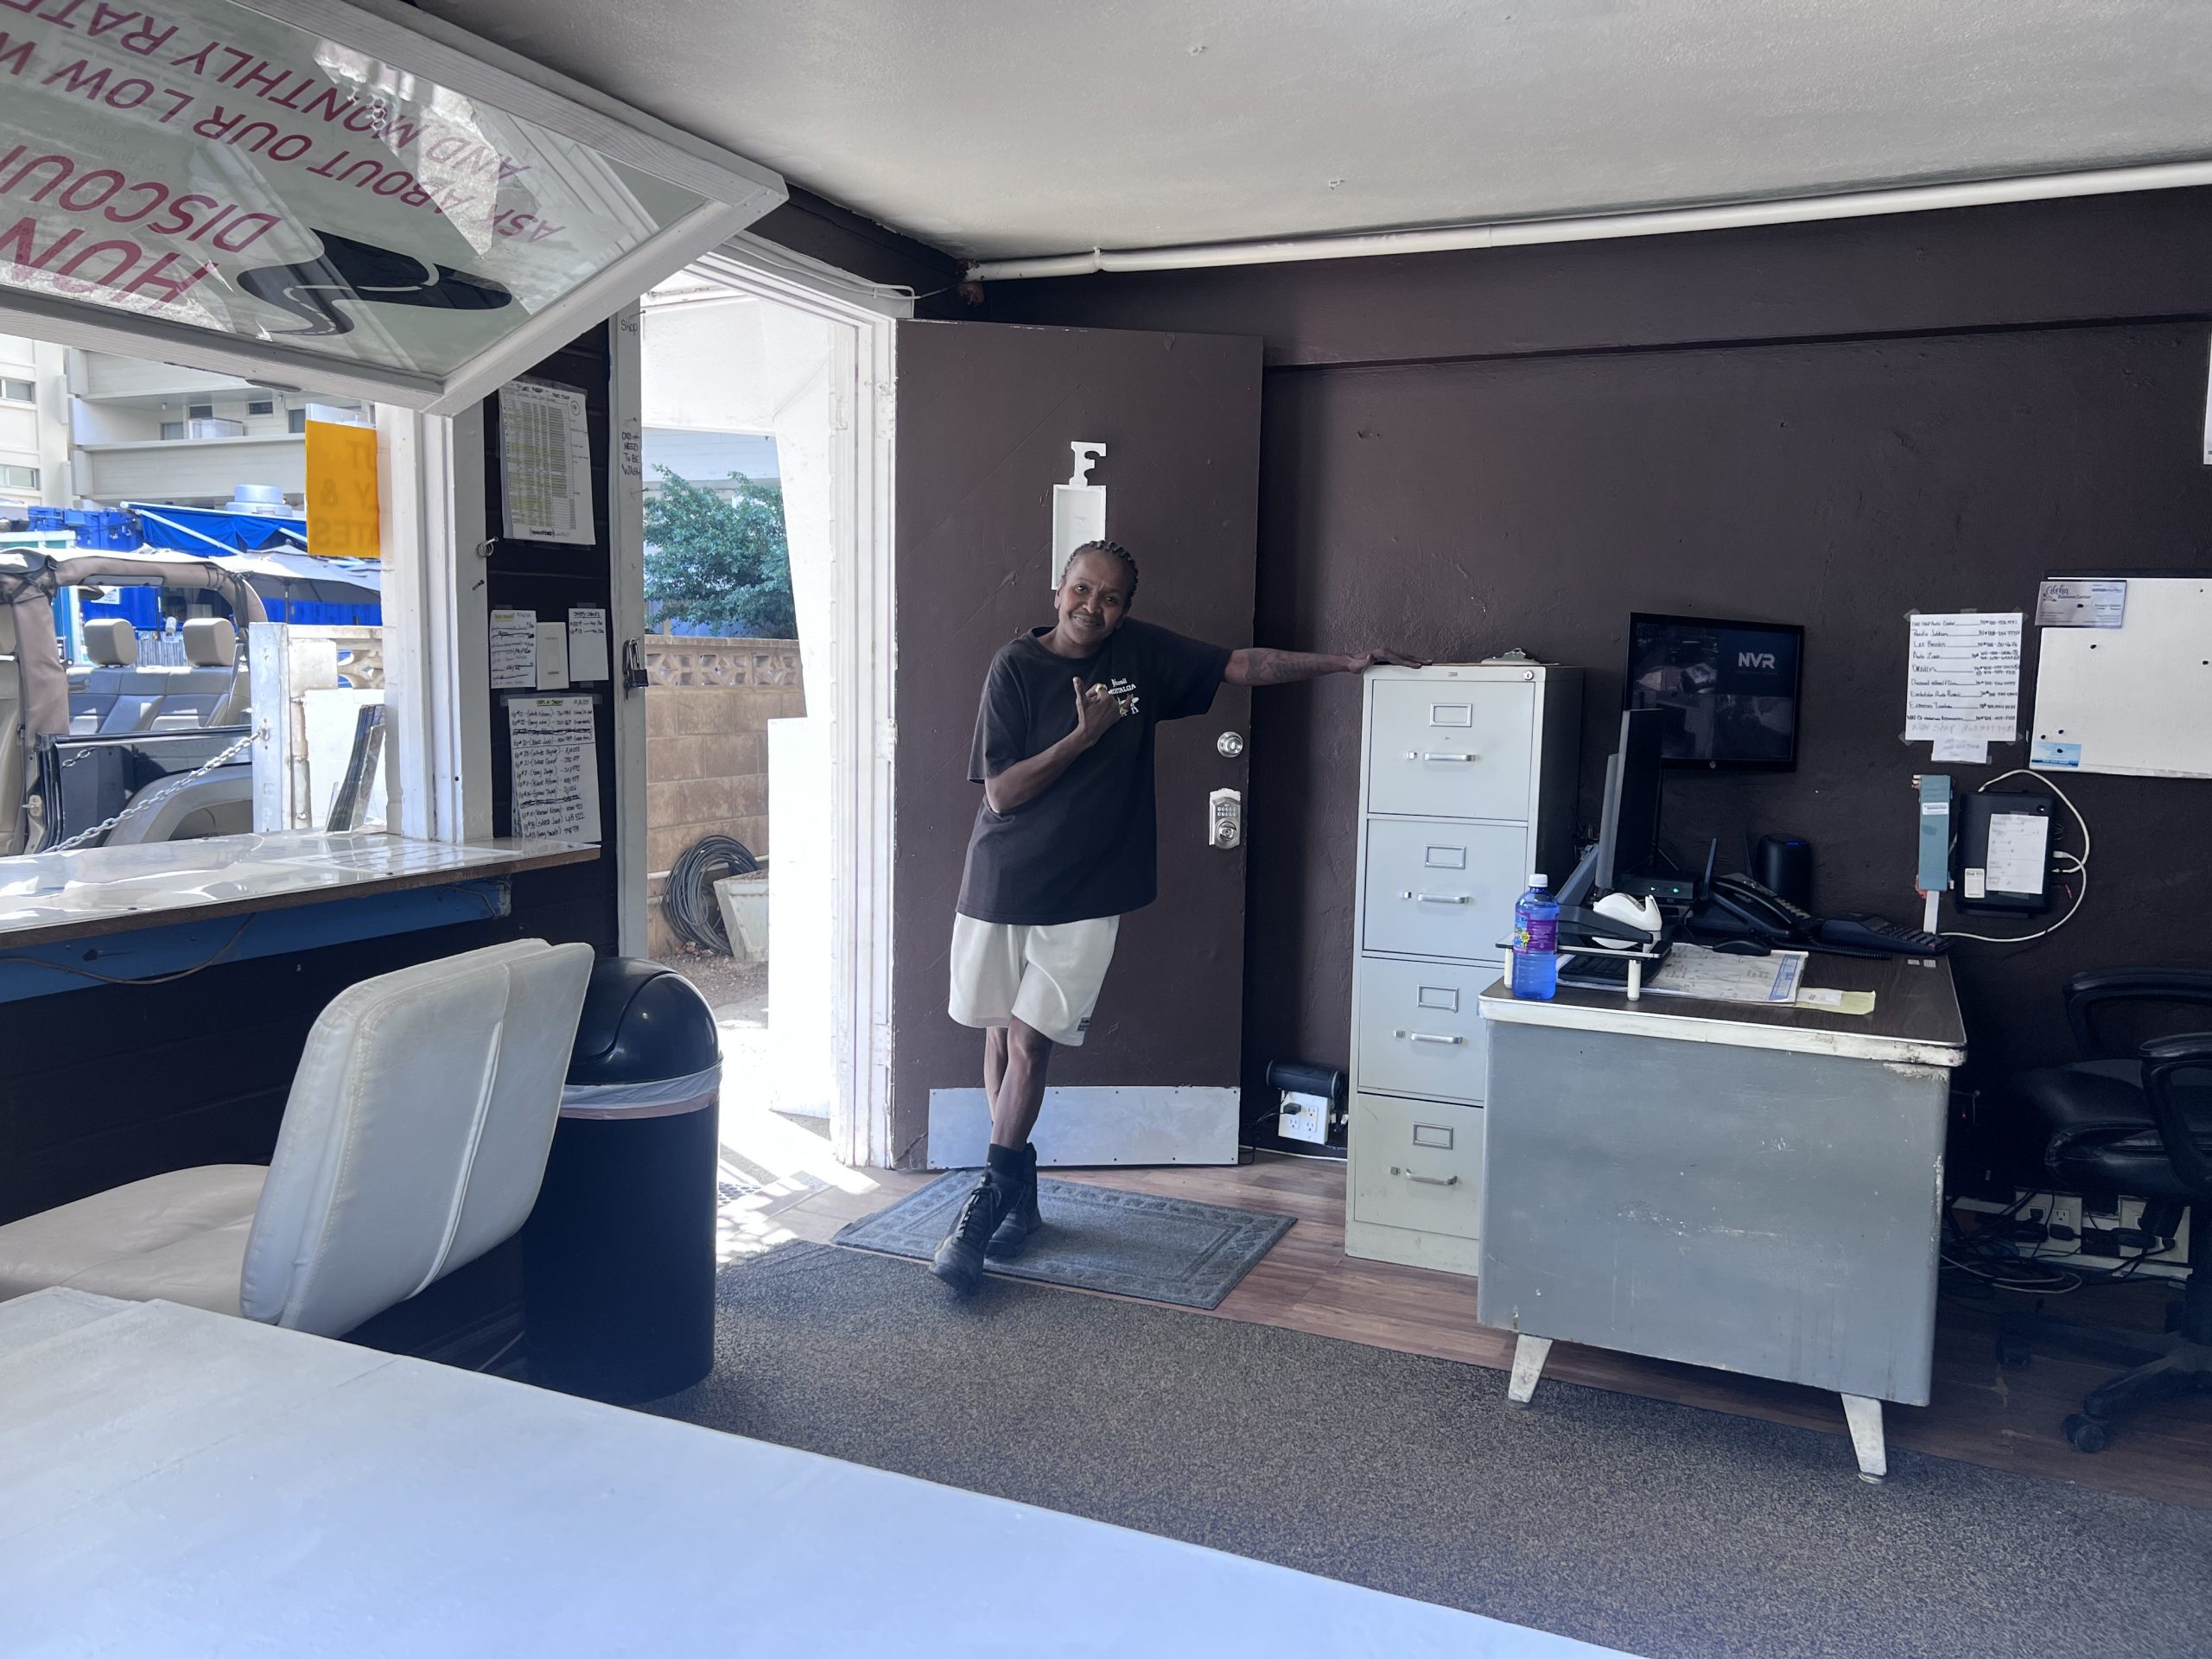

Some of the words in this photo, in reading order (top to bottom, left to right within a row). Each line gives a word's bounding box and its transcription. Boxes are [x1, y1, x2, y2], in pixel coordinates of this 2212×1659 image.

[47, 60, 192, 120] LOW
[176, 42, 429, 149] MONTHLY
[194, 107, 311, 162] OUR
[426, 137, 531, 181] AND
[309, 151, 477, 214] ABOUT
[1738, 652, 1776, 670] NVR
